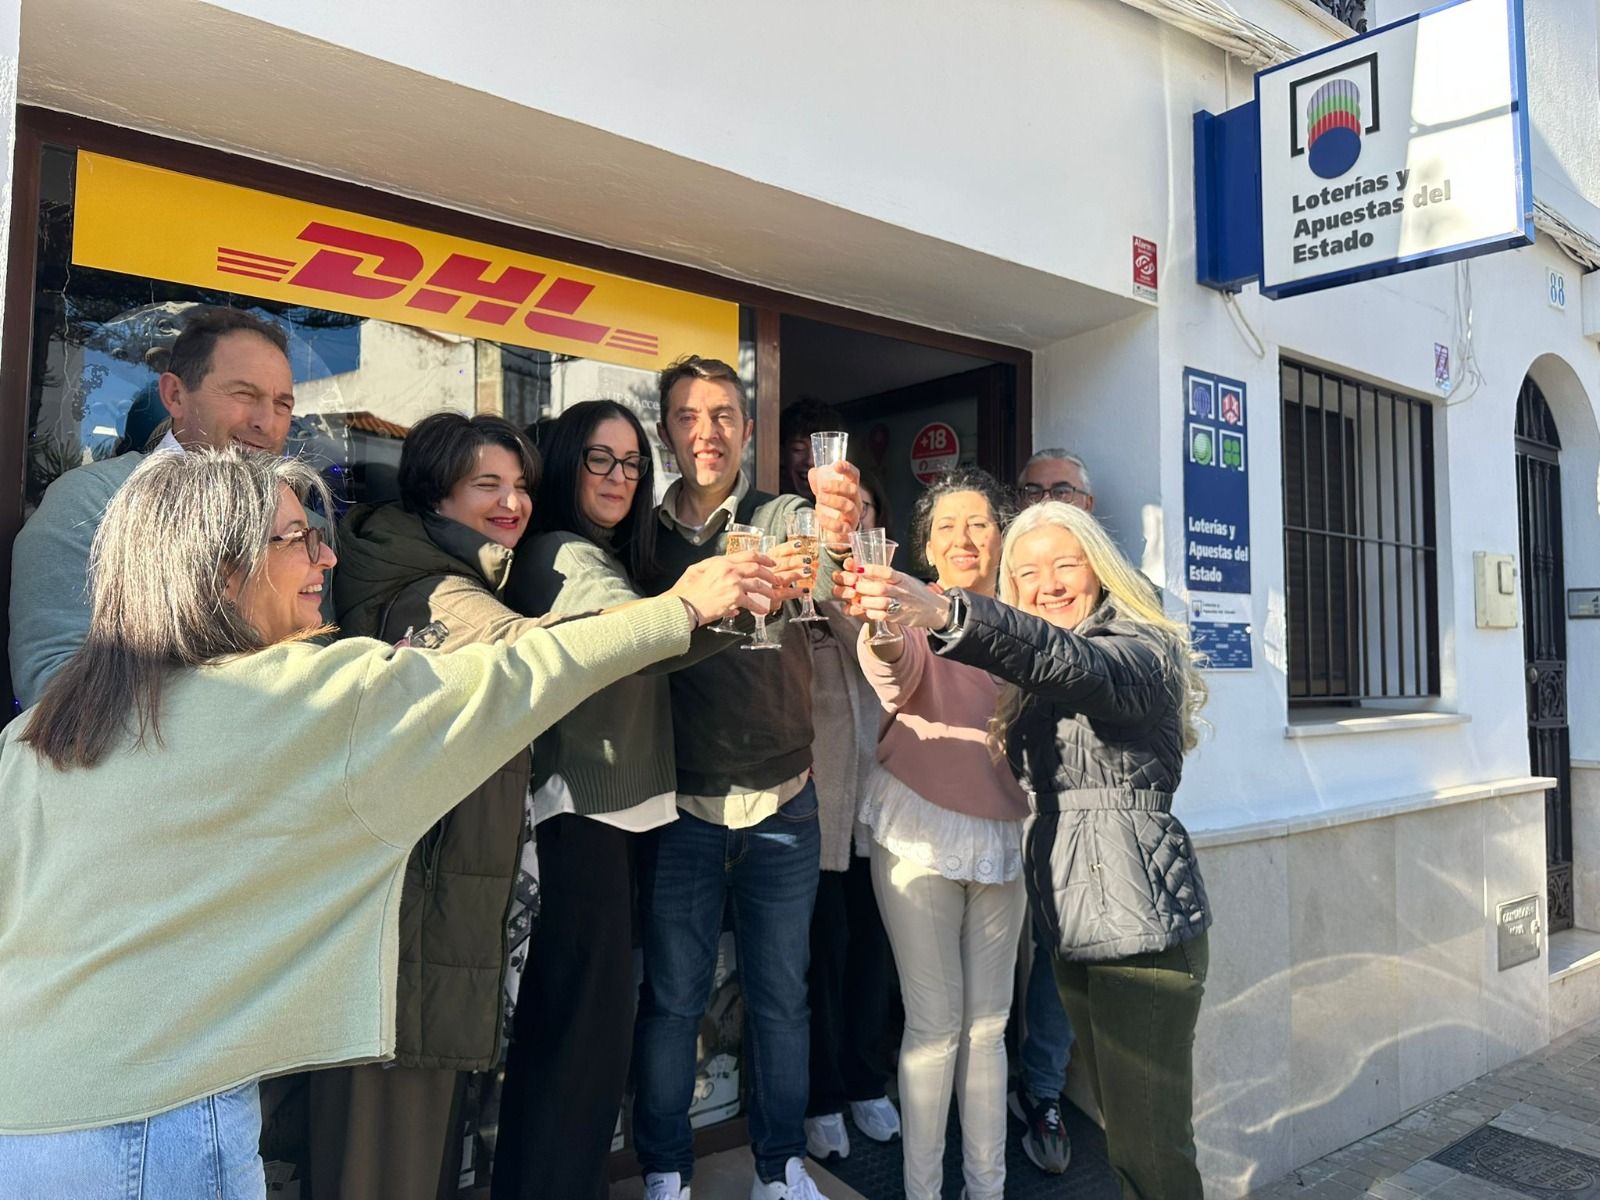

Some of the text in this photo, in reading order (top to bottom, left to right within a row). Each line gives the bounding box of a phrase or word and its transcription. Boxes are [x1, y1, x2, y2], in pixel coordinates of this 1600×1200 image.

[1292, 168, 1411, 214] Loterías y
[1293, 179, 1451, 239] Apuestas del
[1292, 229, 1374, 265] Estado
[286, 220, 609, 343] DHL
[1550, 272, 1565, 306] 88
[920, 429, 947, 450] +18
[1188, 516, 1236, 541] Loterías y
[1188, 541, 1249, 562] Apuestas del
[1189, 565, 1223, 583] Estado
